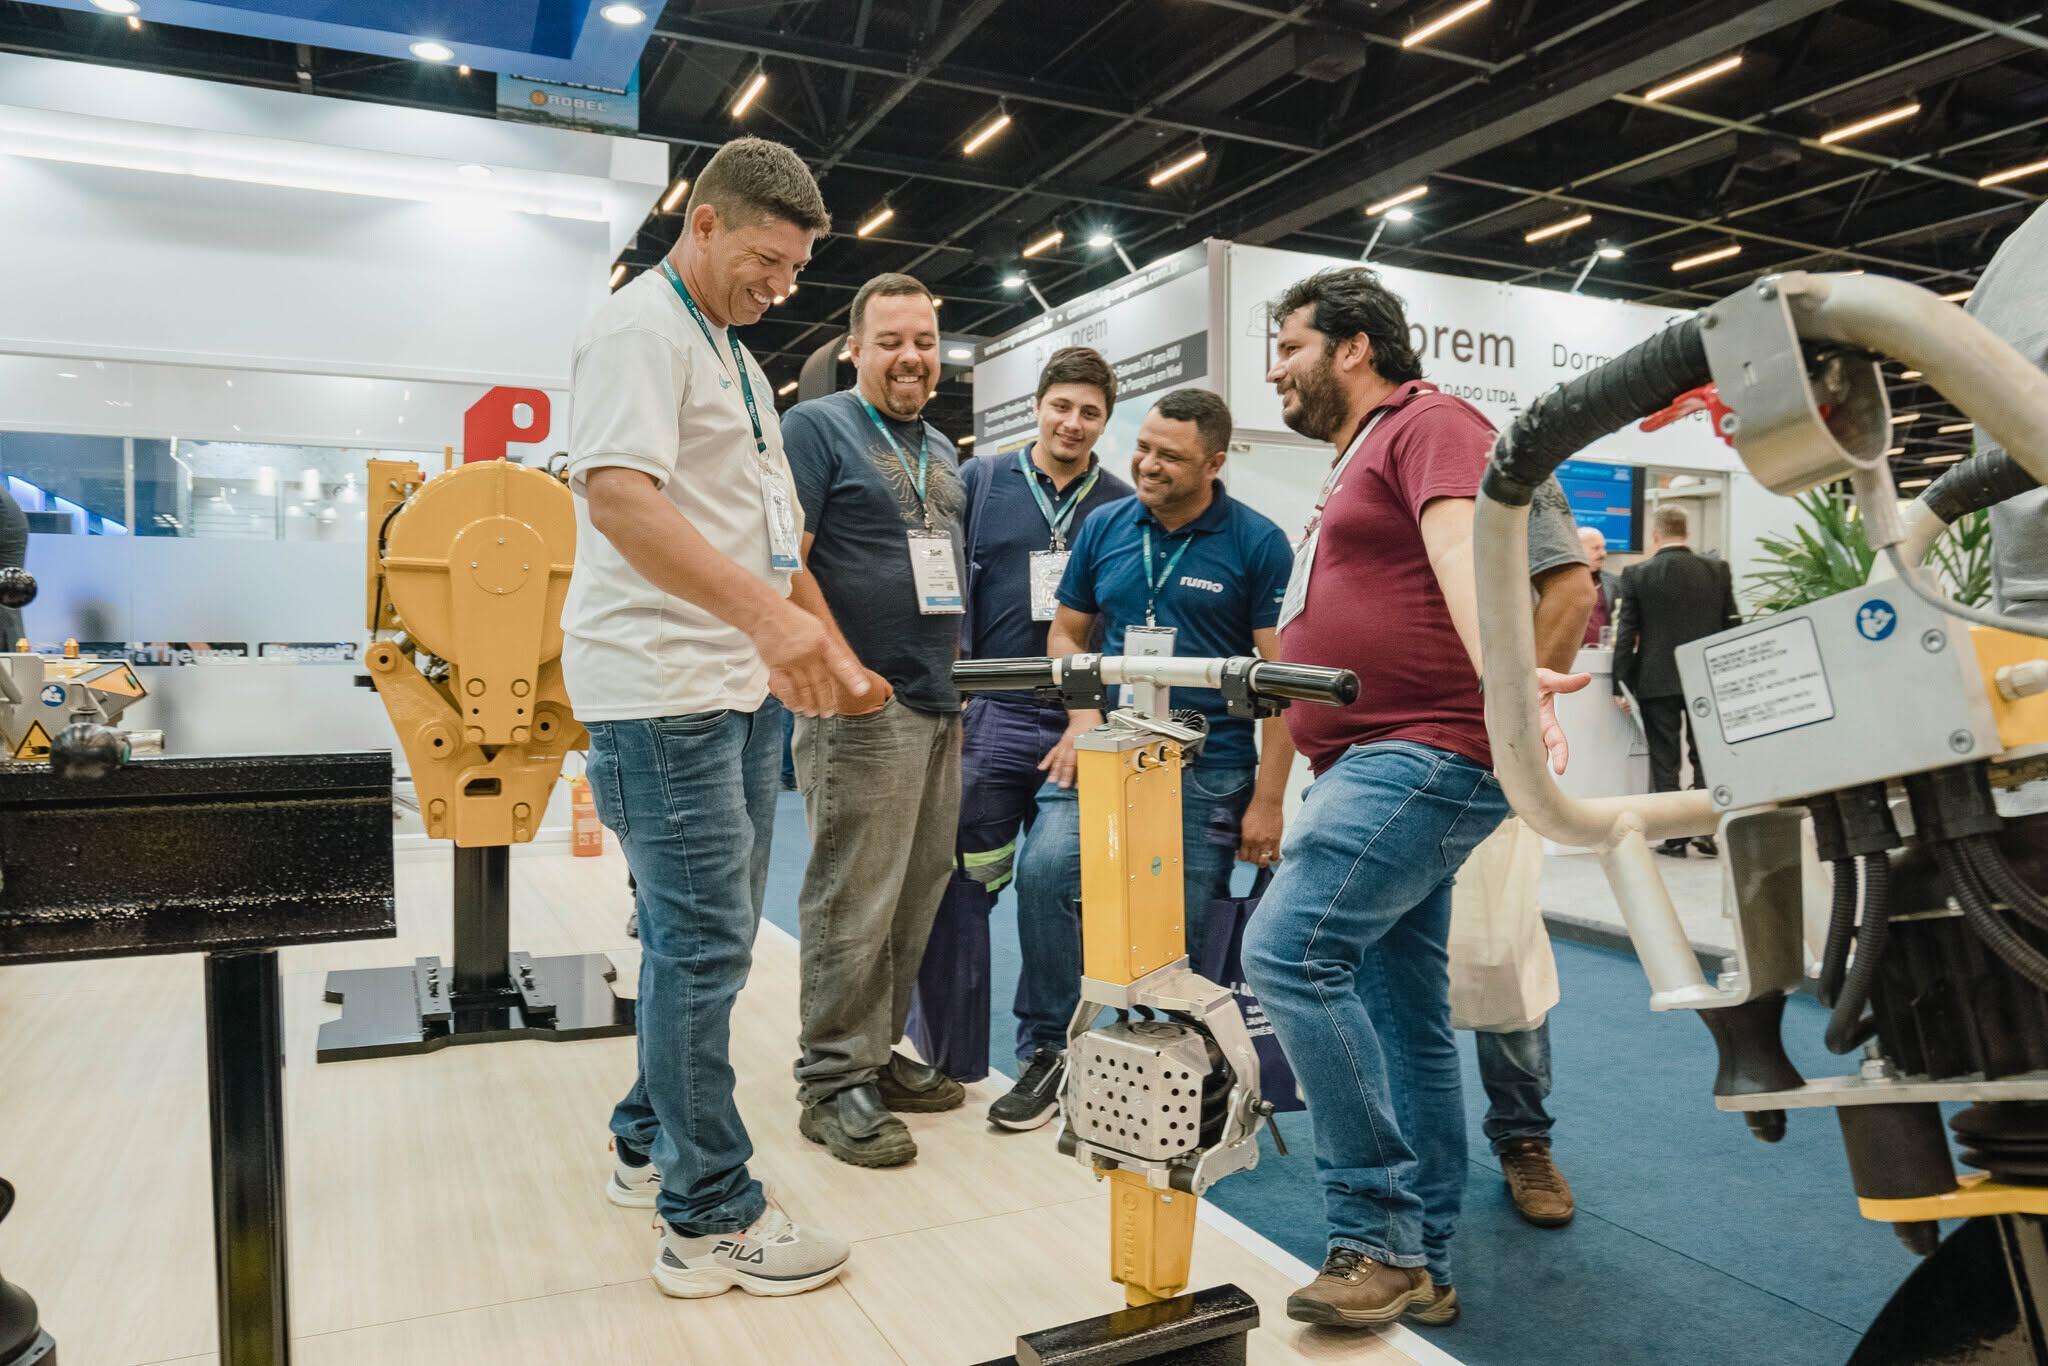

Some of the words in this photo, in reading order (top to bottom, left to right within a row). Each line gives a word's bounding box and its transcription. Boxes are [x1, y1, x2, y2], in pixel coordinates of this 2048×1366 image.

[547, 94, 607, 112] ROBEL
[1552, 343, 1612, 371] Dorm
[1443, 383, 1483, 400] DADO
[1487, 388, 1517, 404] LTDA
[1179, 576, 1224, 594] rumo
[711, 1240, 764, 1265] FILA
